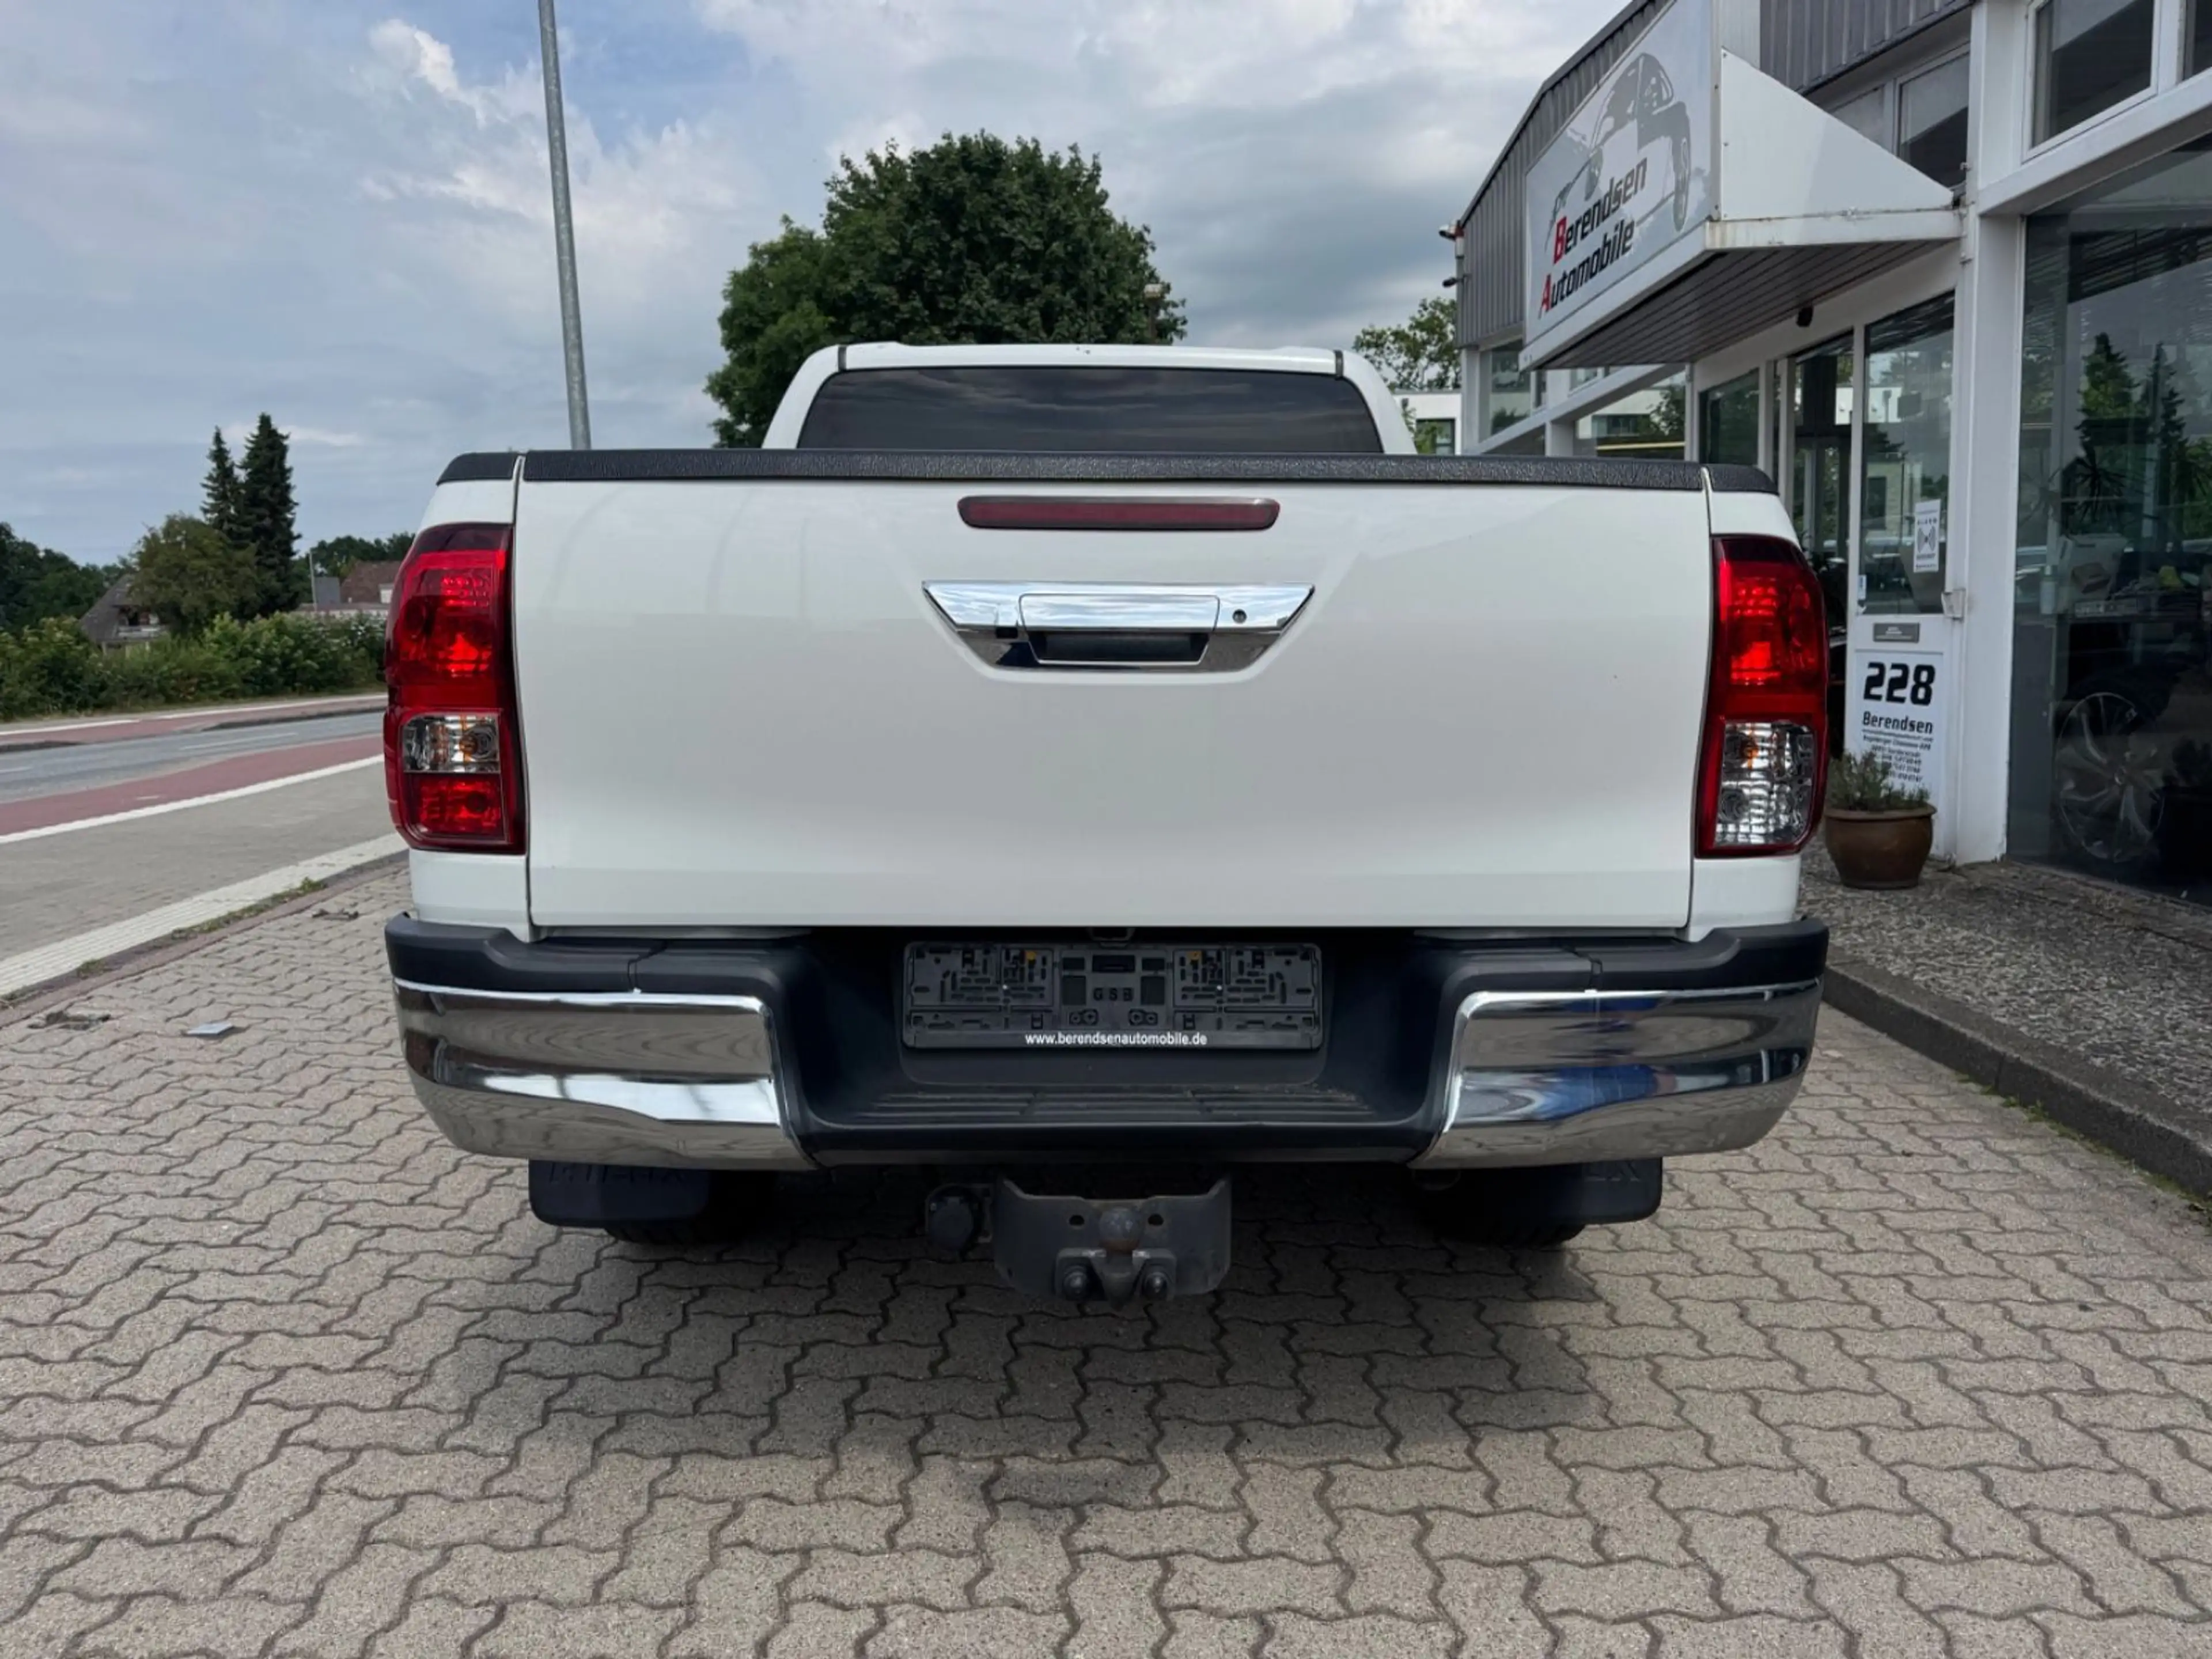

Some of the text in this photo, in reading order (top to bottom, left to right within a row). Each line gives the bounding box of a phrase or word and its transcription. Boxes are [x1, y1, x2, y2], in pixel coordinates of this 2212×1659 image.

[1553, 158, 1647, 266] Berendsen
[1539, 220, 1634, 319] Automobile
[1863, 662, 1936, 706] 228
[1862, 711, 1933, 734] Berendsen
[1025, 1032, 1207, 1046] www.berendsenautomobile.de
